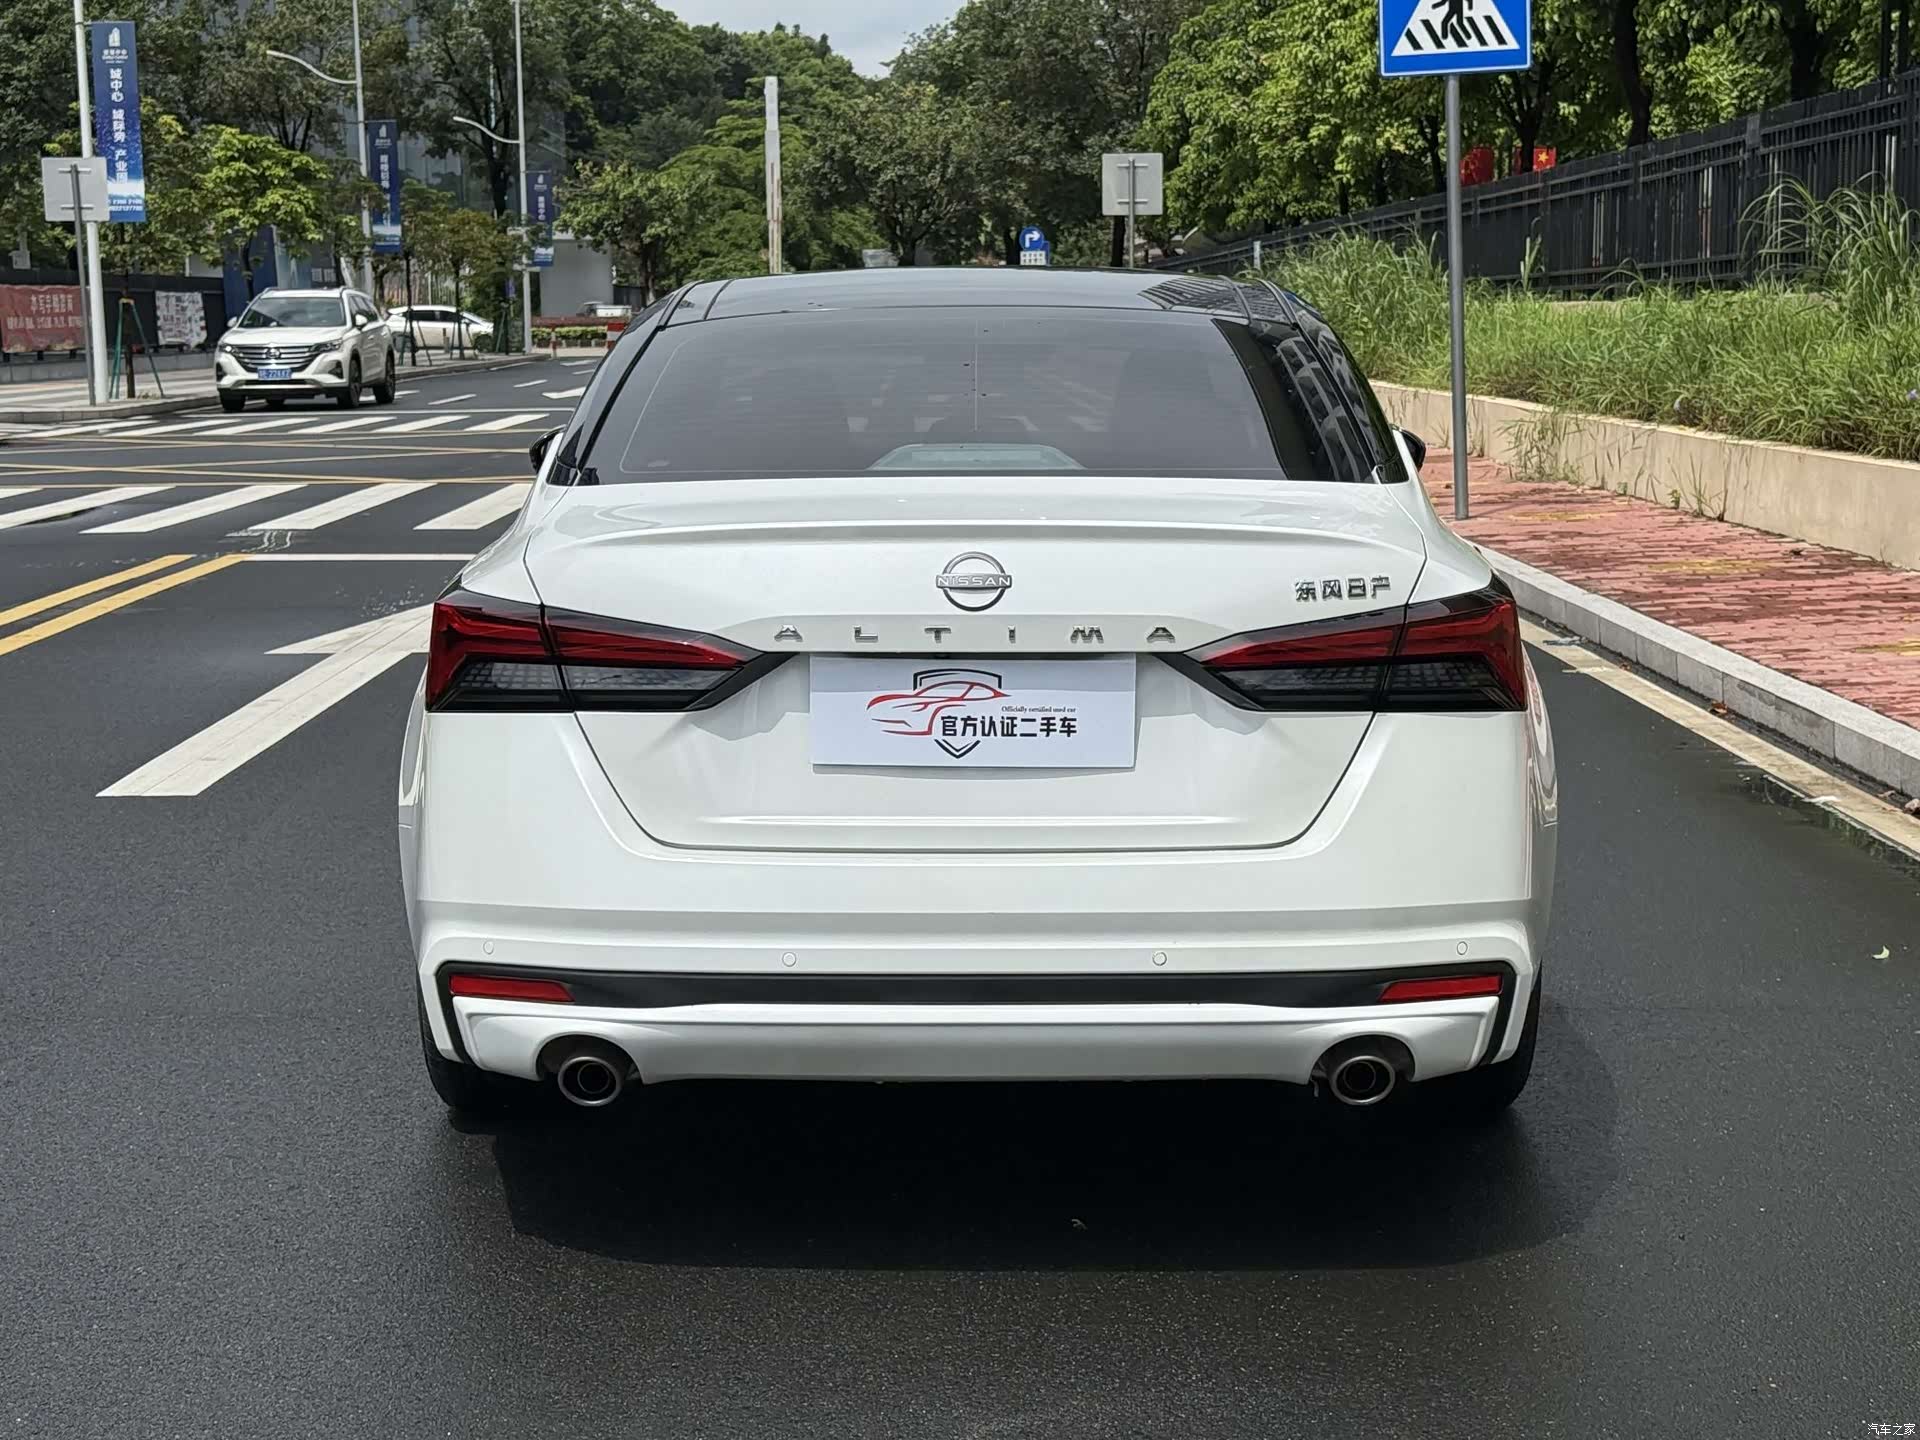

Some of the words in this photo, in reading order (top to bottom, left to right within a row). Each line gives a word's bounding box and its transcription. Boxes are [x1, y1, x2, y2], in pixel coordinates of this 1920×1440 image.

[937, 575, 1011, 587] NISSAN
[1295, 575, 1391, 602] 东风日产
[774, 624, 1176, 643] ALTIMA
[1001, 705, 1027, 714] Officially
[940, 715, 1078, 738] 官方认证二手车
